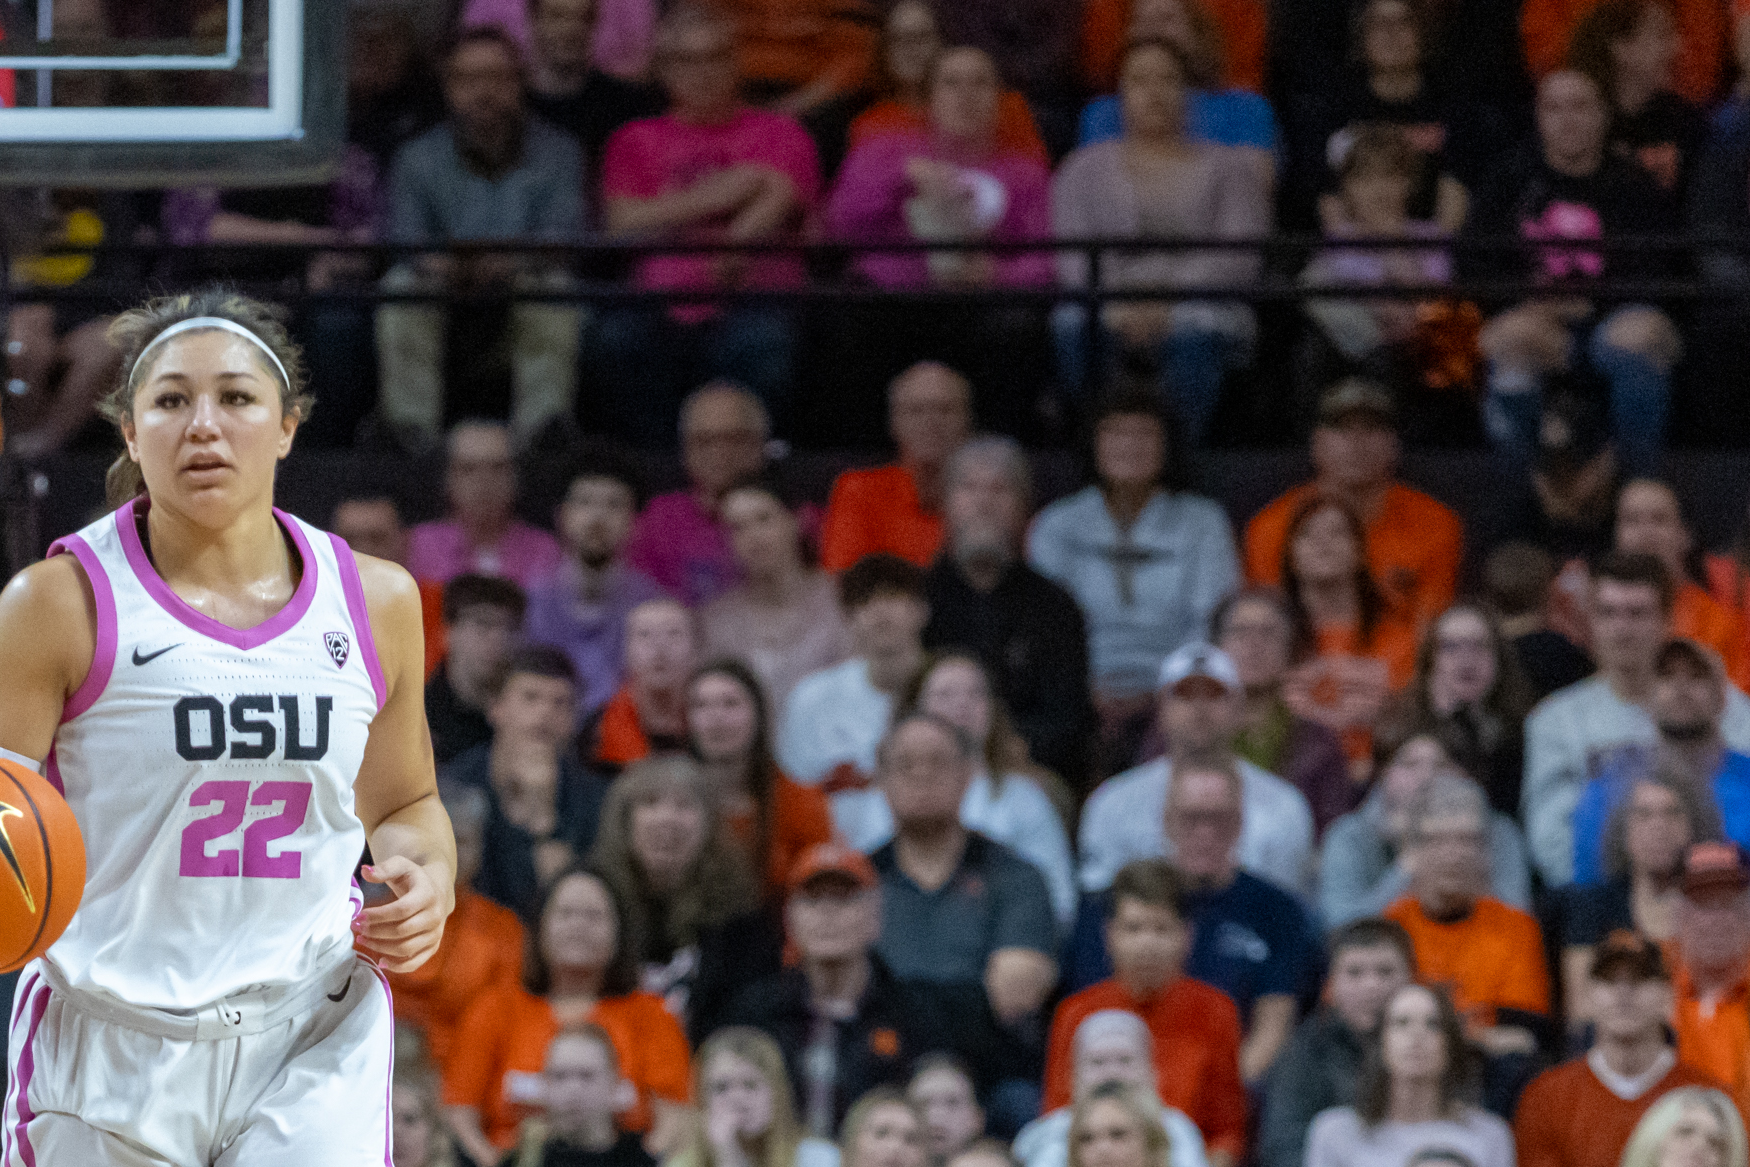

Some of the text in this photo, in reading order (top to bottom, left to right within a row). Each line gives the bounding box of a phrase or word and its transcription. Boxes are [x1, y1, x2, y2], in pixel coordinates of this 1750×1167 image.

[325, 632, 348, 653] PAC
[332, 646, 345, 660] 12
[173, 695, 333, 761] OSU
[179, 780, 313, 879] 22
